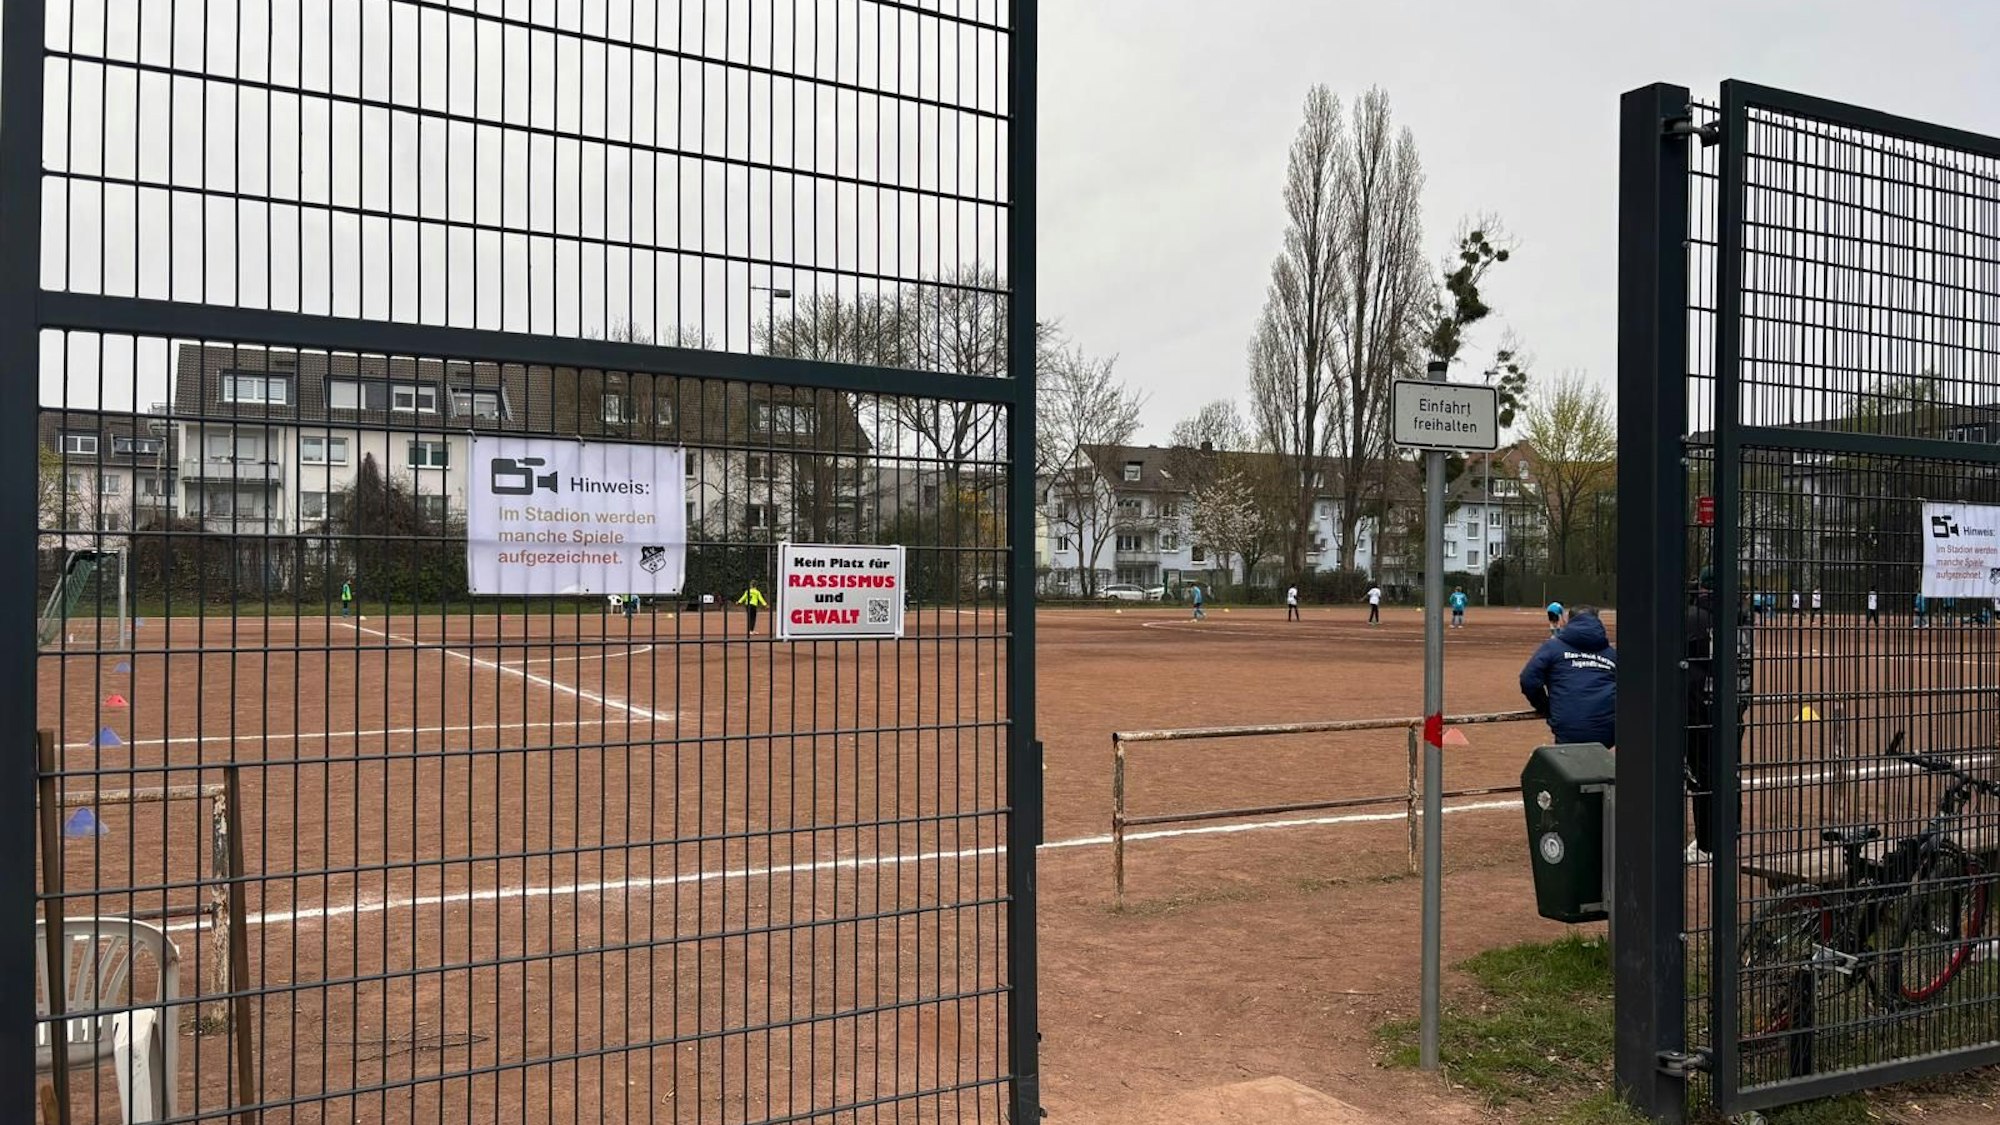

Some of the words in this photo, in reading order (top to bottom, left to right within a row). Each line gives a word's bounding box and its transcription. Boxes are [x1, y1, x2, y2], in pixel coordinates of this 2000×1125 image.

[1419, 398, 1471, 415] Einfahrt
[1414, 416, 1477, 433] freihalten
[571, 476, 650, 495] Hinweis:
[498, 506, 519, 522] Im
[525, 507, 590, 524] Stadion
[595, 511, 656, 525] werden
[498, 528, 567, 544] manche
[572, 530, 624, 547] Spiele
[1963, 526, 1995, 537] Hinweis:
[498, 549, 623, 567] aufgezeichnet.
[794, 557, 825, 568] Kein
[830, 558, 864, 568] Platz
[869, 558, 890, 569] für
[789, 574, 895, 588] RASSISMUS
[815, 592, 843, 603] und
[790, 609, 859, 624] GEWALT
